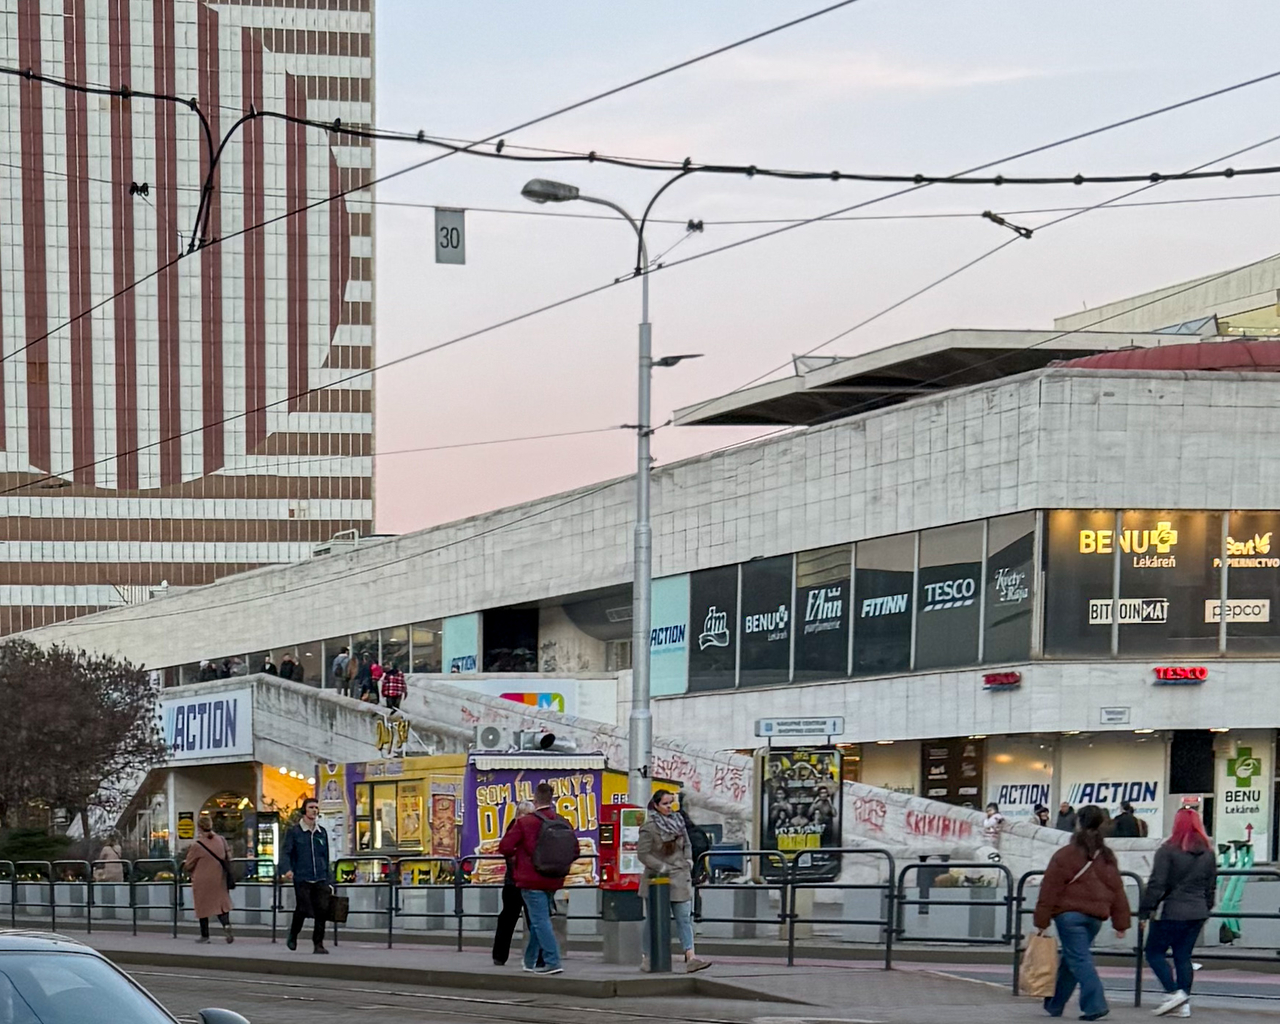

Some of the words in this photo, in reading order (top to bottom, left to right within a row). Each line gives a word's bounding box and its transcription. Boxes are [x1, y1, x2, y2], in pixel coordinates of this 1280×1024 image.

[439, 226, 460, 249] 30
[1079, 530, 1150, 553] BENU
[1133, 555, 1175, 568] Lekáreň
[924, 578, 975, 602] TESCO
[861, 594, 908, 618] FITINN
[745, 612, 776, 633] BENU
[650, 624, 686, 647] ACTION
[1153, 666, 1208, 680] TESCO
[174, 698, 238, 751] ACTION
[476, 783, 512, 806] SOM
[998, 784, 1050, 804] ACTION
[1078, 781, 1158, 804] ACTION
[1225, 790, 1261, 802] BENU
